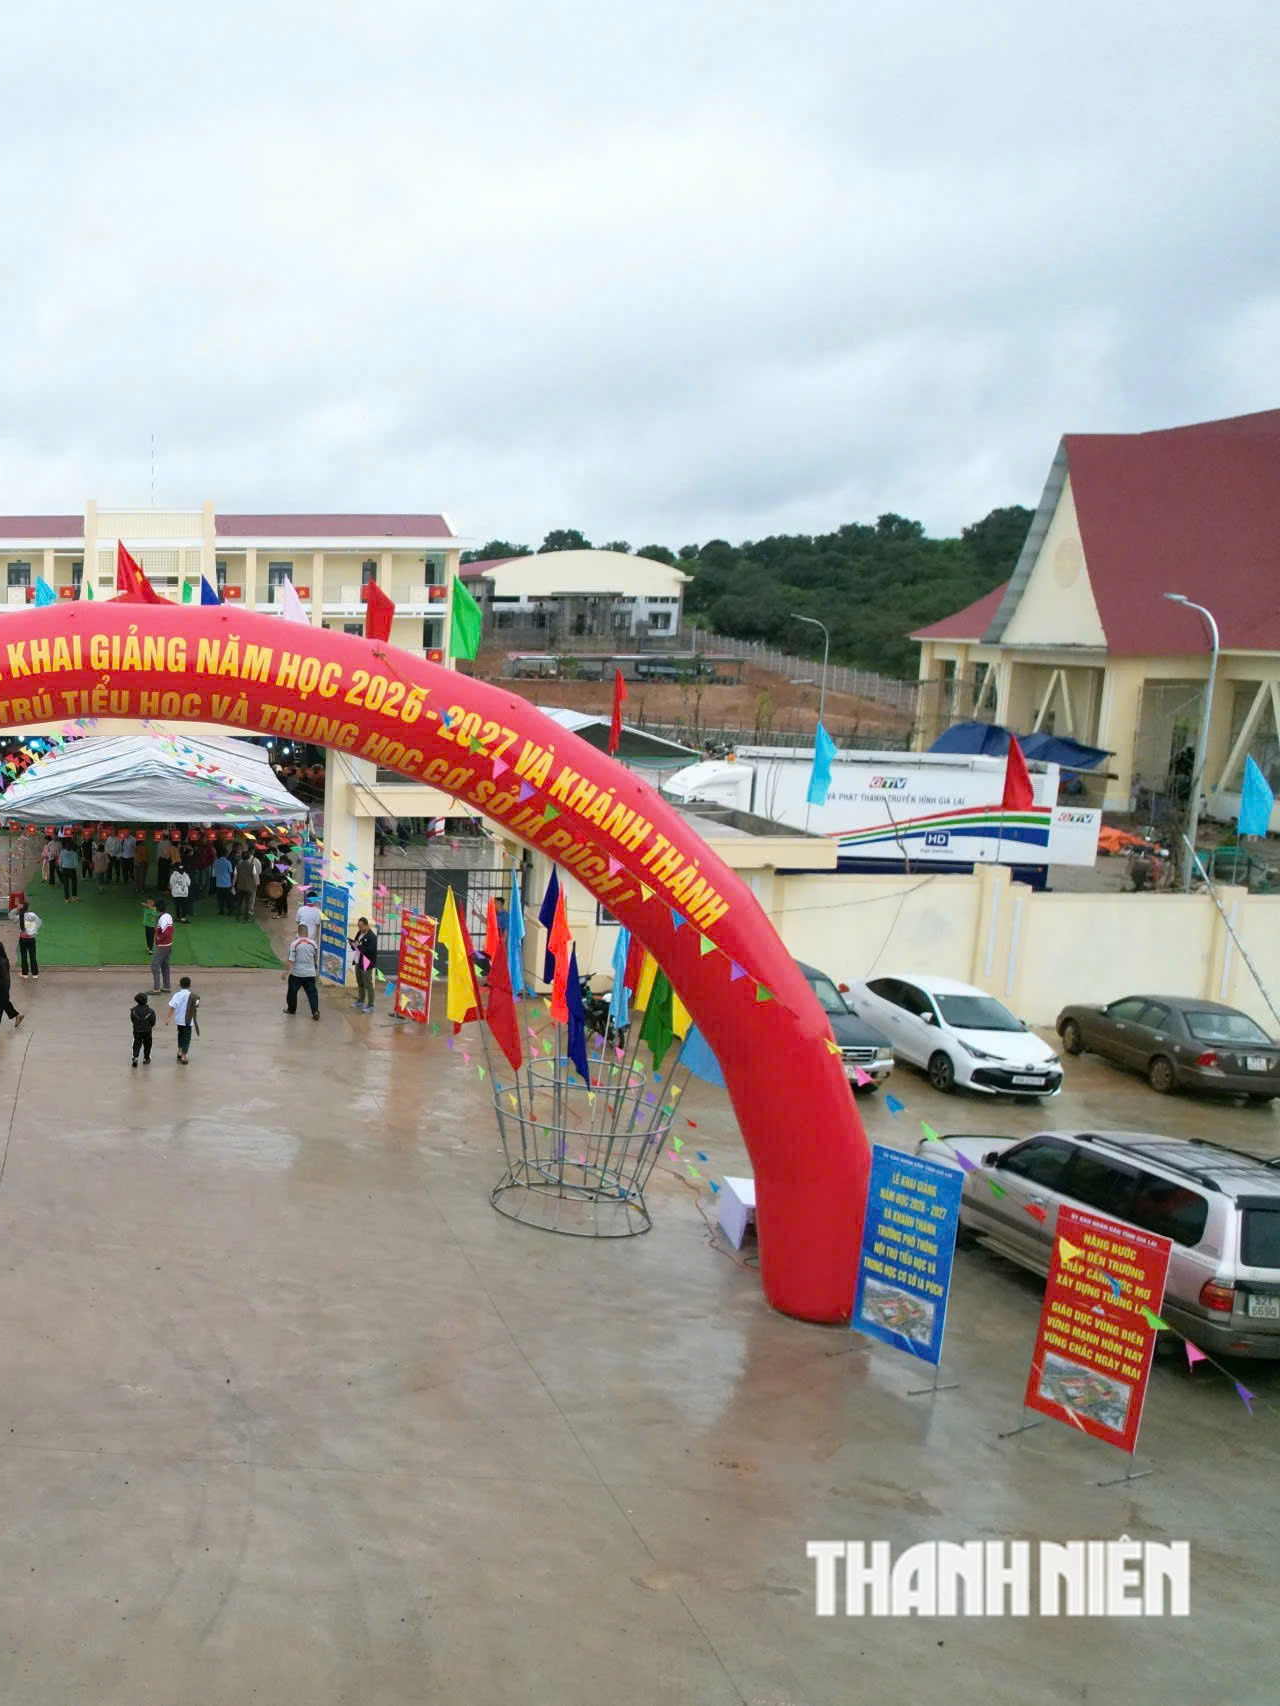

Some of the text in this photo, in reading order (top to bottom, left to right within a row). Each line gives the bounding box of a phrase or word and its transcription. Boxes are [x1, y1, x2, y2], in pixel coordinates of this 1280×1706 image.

[7, 634, 82, 678] KHAI
[90, 624, 187, 672] GIẢNG
[196, 633, 273, 683] NĂM
[276, 651, 342, 700] HỌC
[344, 670, 427, 723] 2026
[437, 705, 519, 760] 2027
[514, 740, 555, 788] VÀ
[549, 766, 653, 852] KHÁNH
[640, 833, 730, 929] THÀNH
[61, 674, 129, 716] TIỂU
[211, 692, 248, 725] VÀ
[258, 703, 360, 748] TRUNG
[423, 758, 475, 790] CƠ
[928, 834, 946, 845] HD
